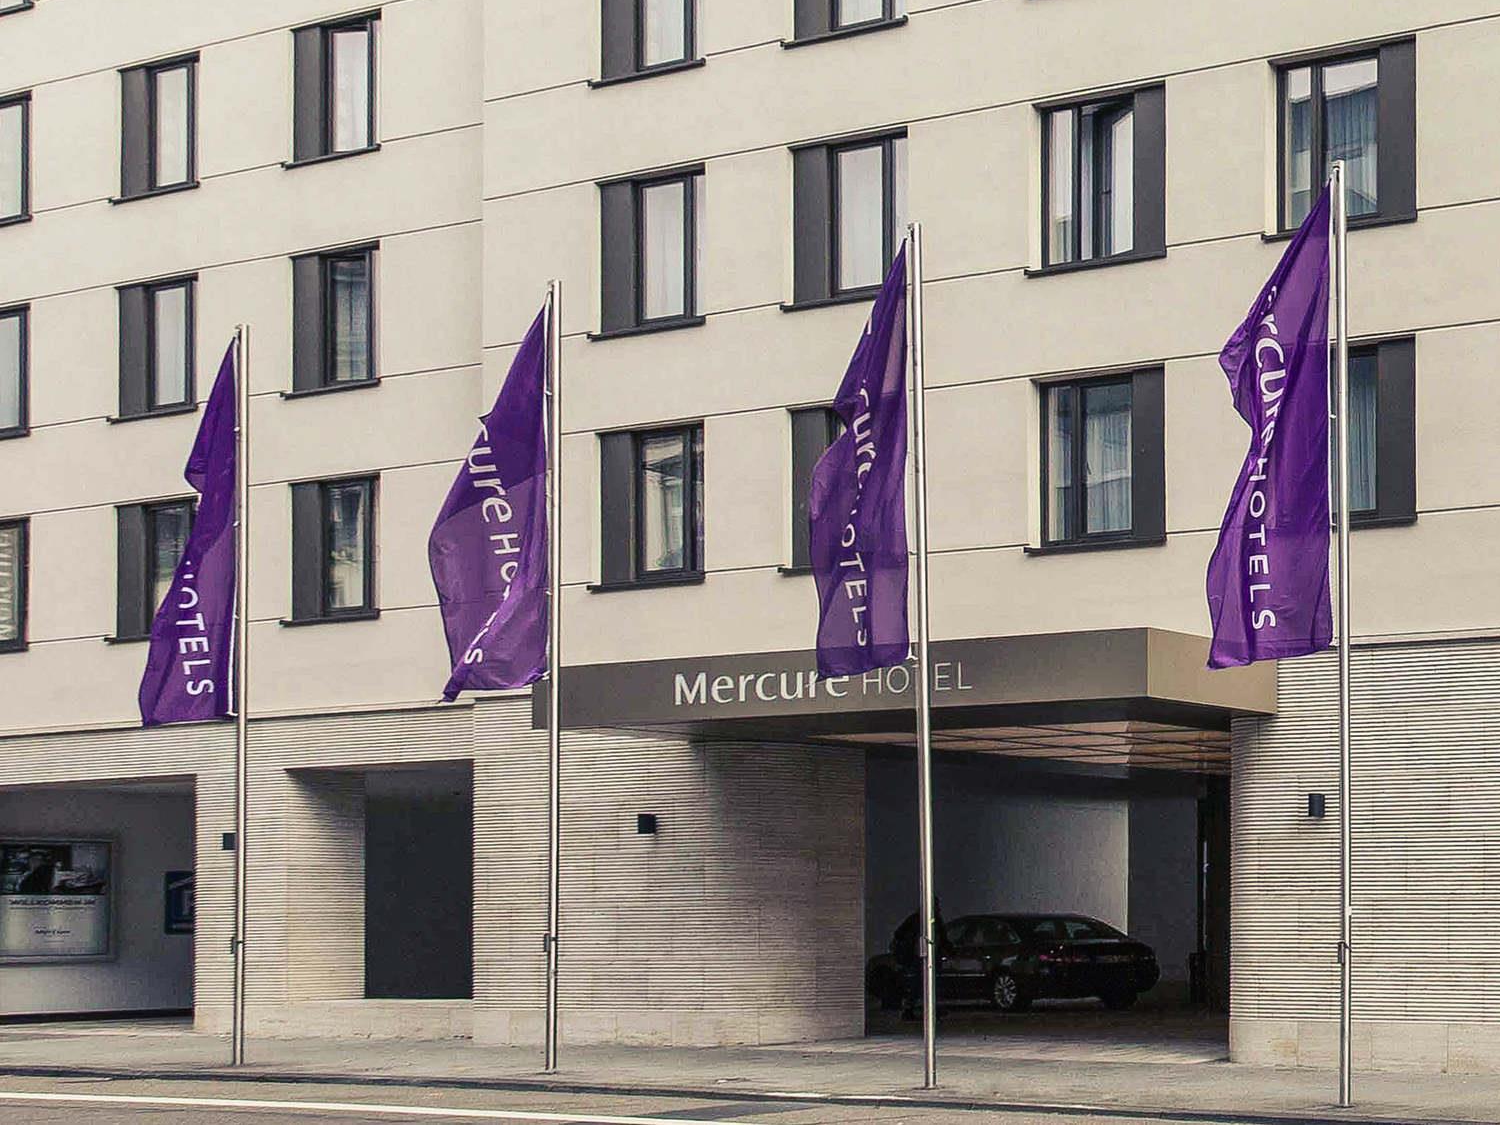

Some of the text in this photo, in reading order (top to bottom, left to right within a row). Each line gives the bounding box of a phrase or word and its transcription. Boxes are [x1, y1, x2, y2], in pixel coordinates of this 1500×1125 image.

[1248, 458, 1277, 630] HOTELS
[175, 560, 215, 696] OTELS
[673, 661, 974, 706] Mercure HOEL
